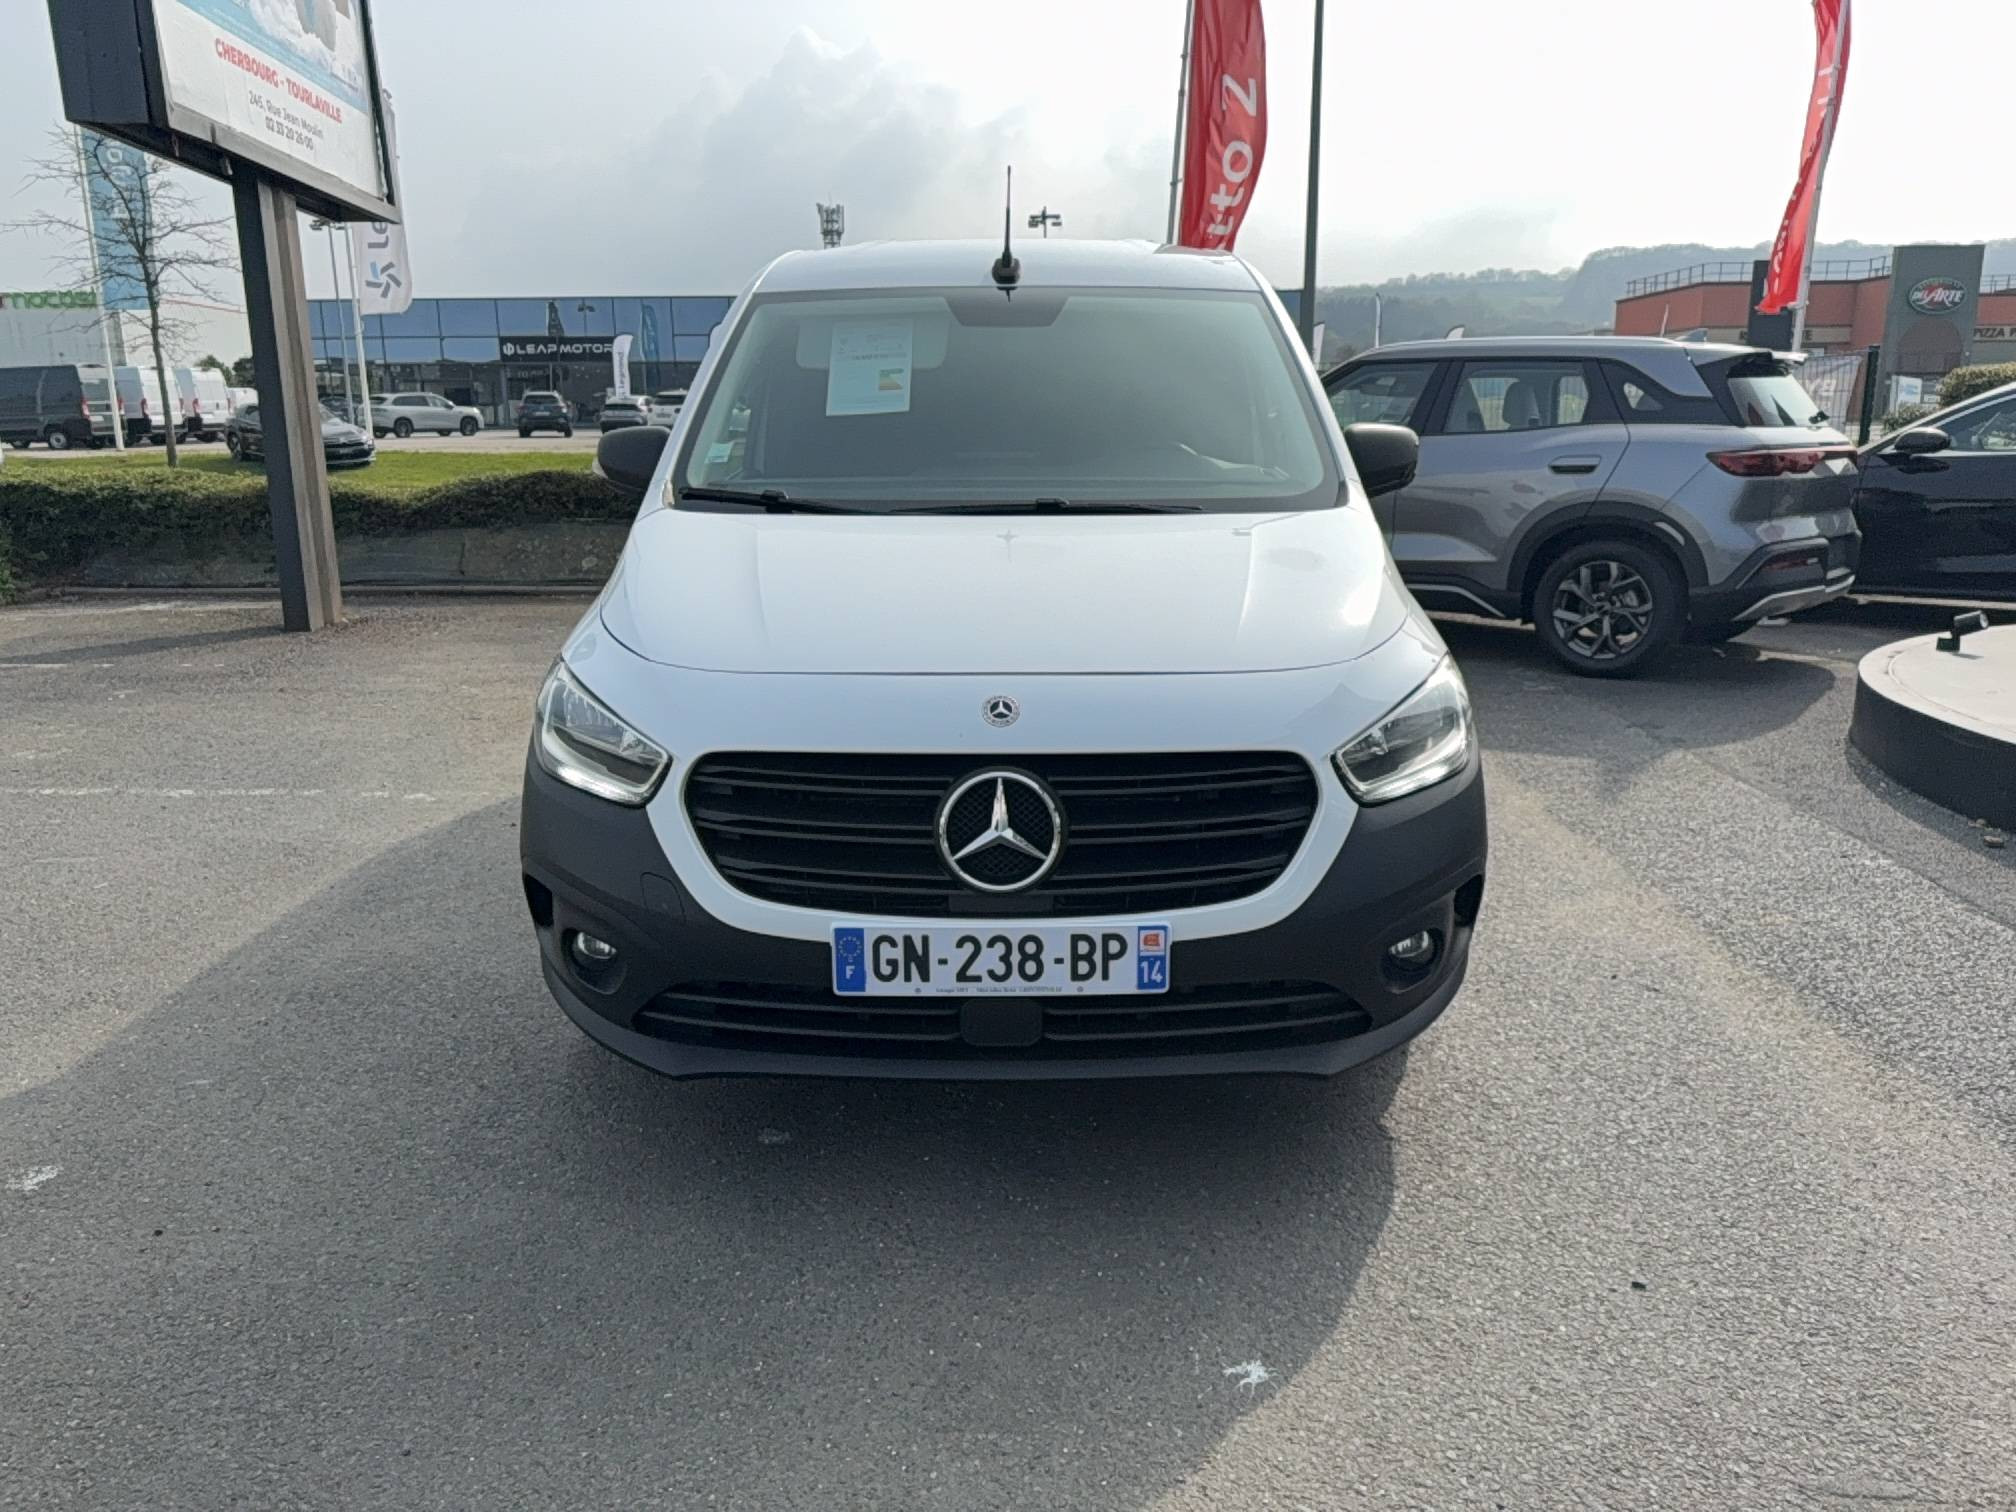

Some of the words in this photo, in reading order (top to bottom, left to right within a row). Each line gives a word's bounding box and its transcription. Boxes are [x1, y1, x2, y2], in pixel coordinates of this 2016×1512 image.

[214, 37, 279, 89] CHERBOURG
[285, 77, 343, 124] TOURLAVILLE
[845, 965, 856, 980] F
[871, 932, 1129, 984] GN-238-BP
[1140, 960, 1164, 984] 14
